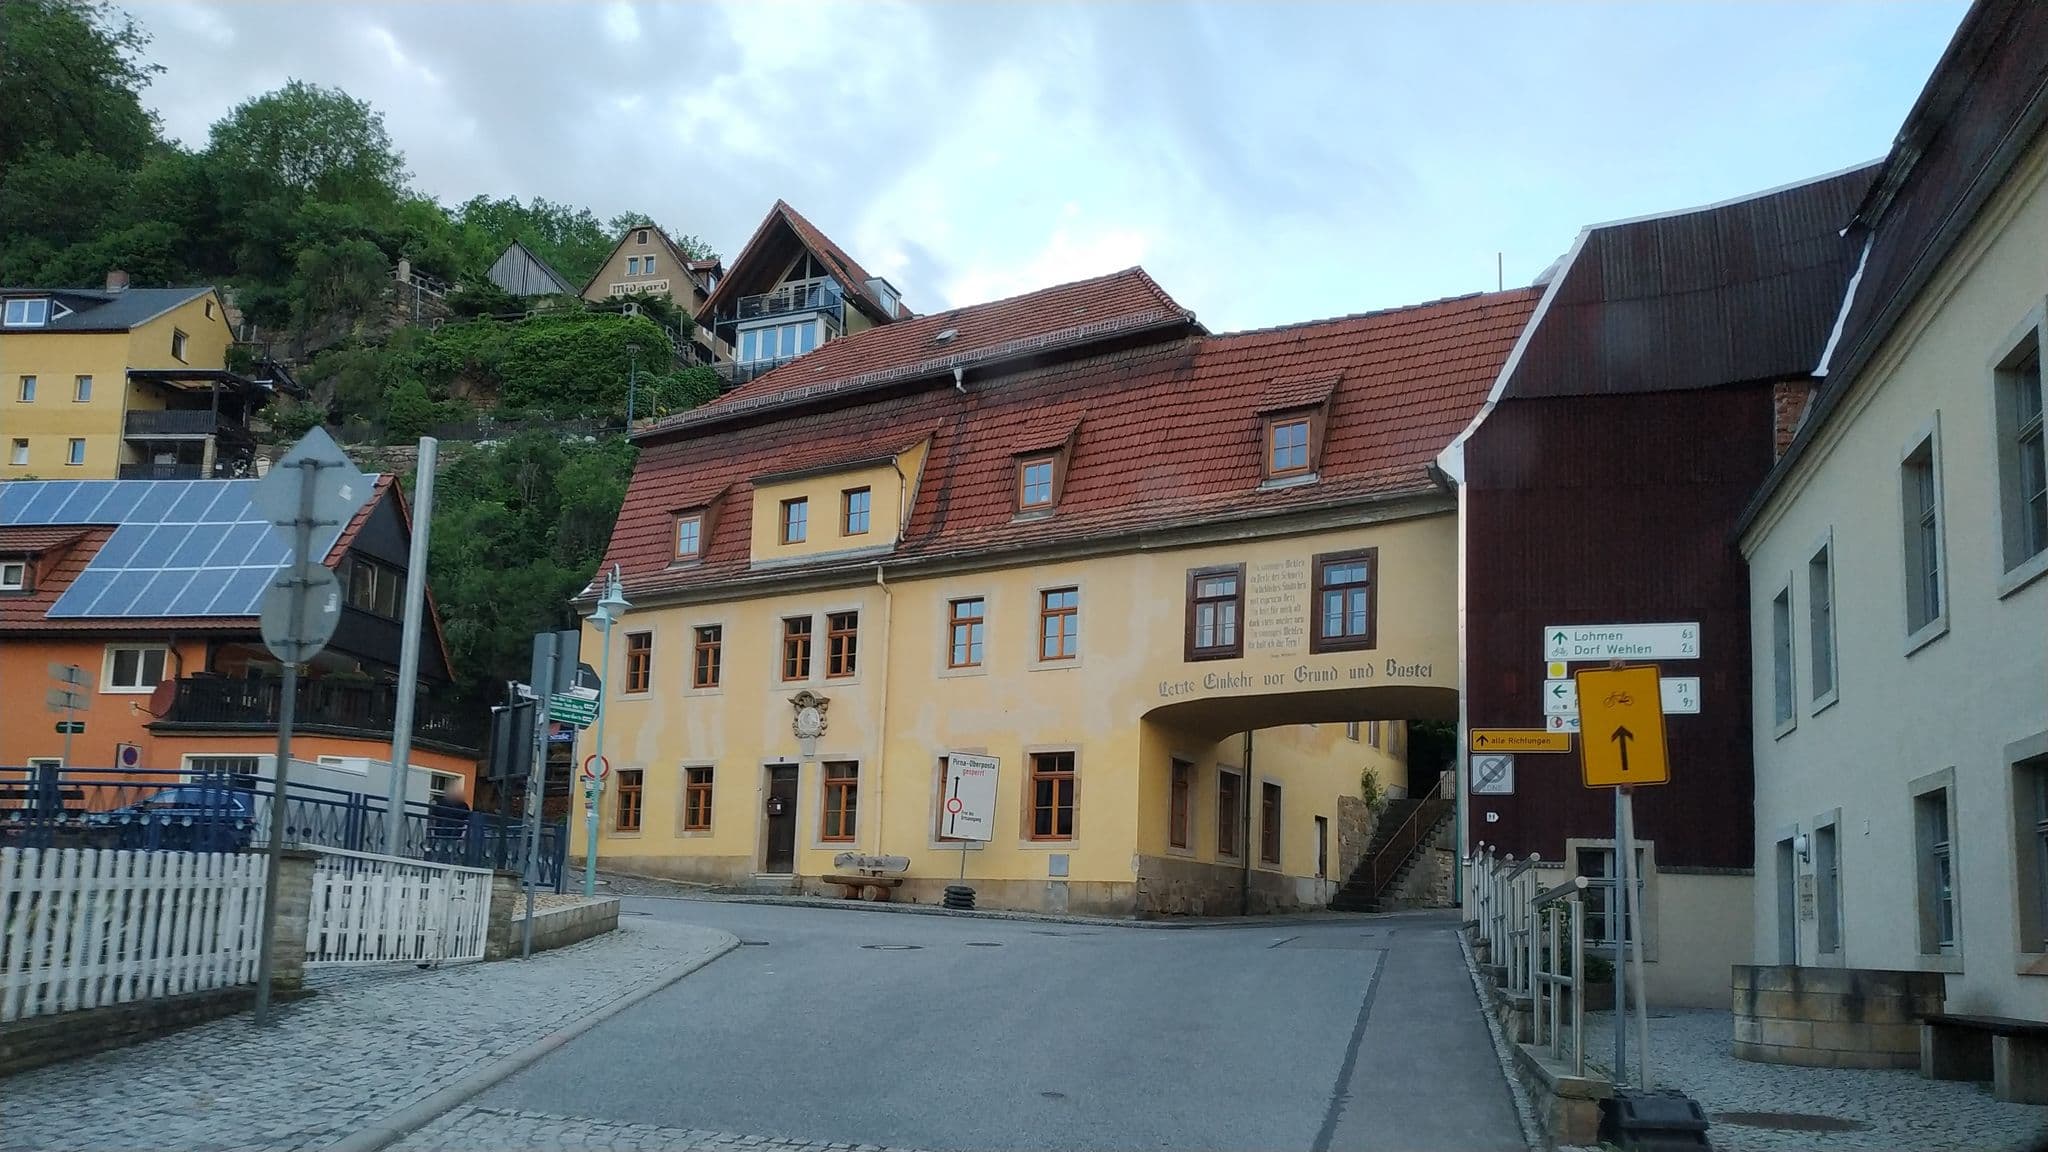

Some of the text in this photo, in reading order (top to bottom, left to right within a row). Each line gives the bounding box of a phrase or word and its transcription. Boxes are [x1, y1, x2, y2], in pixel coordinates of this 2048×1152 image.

[612, 281, 668, 295] Midgard
[1574, 631, 1623, 642] Lohmen
[1574, 645, 1600, 655] Dorf
[1606, 644, 1652, 654] Wehlen
[1158, 680, 1196, 697] Letzte
[1203, 671, 1254, 690] Einkehr
[1264, 672, 1286, 687] vor
[1294, 665, 1338, 683] Grund
[1349, 663, 1374, 680] und
[1676, 683, 1687, 693] 31
[1508, 737, 1551, 746] Richtungen
